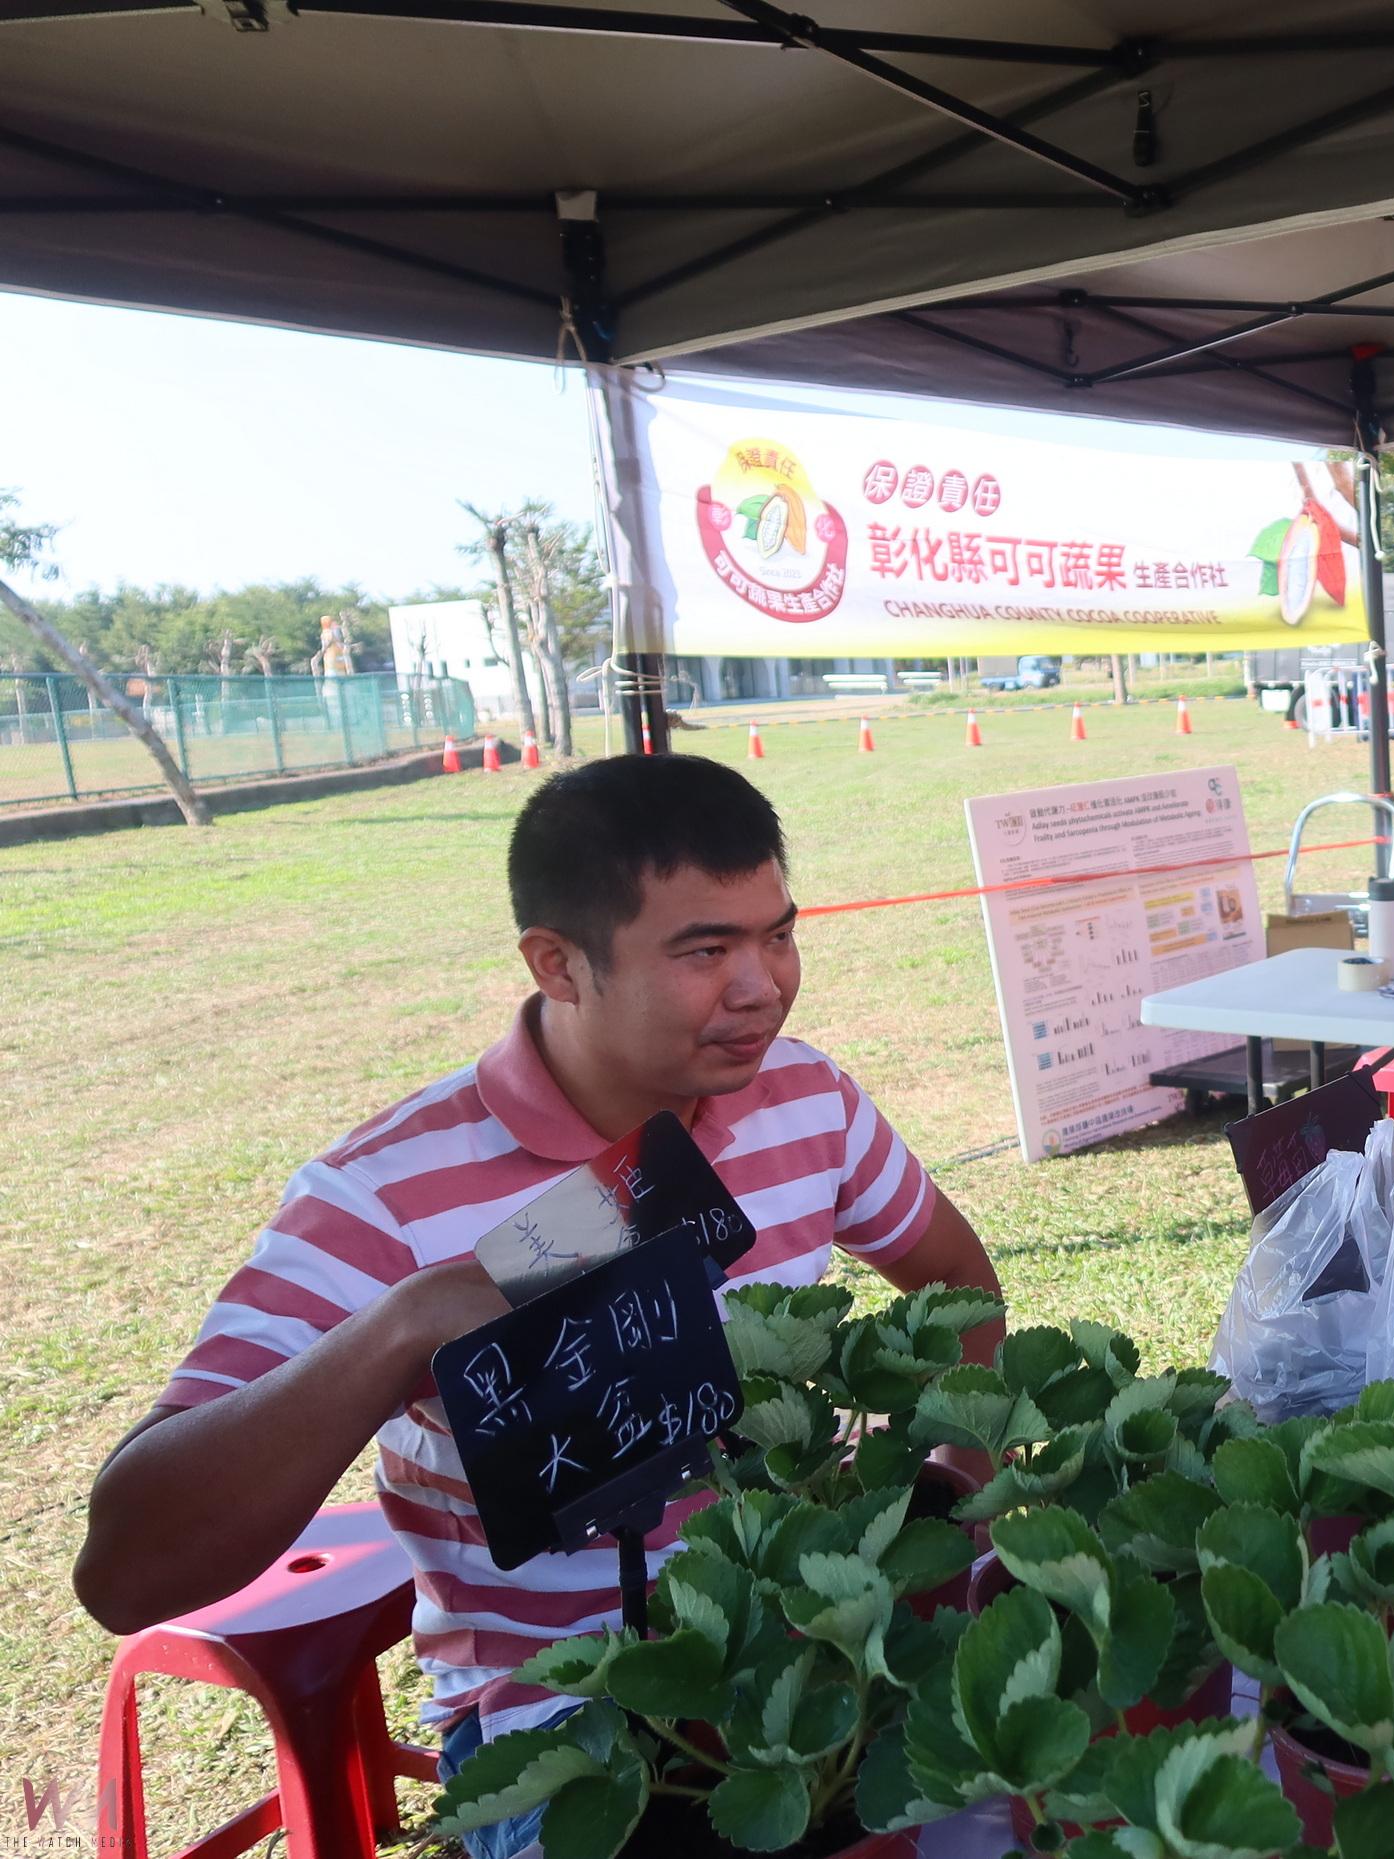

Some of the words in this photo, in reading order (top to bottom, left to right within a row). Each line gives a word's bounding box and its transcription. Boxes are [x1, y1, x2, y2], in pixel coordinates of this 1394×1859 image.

[863, 461, 1001, 515] 保證責任
[866, 521, 1128, 591] 彰化縣可可蔬果
[1133, 560, 1229, 589] 生產合作社
[884, 599, 996, 620] CHANGHUA
[995, 605, 1063, 622] COUNTY
[1066, 608, 1123, 624] COCOA
[463, 1279, 680, 1436] 黑金剛
